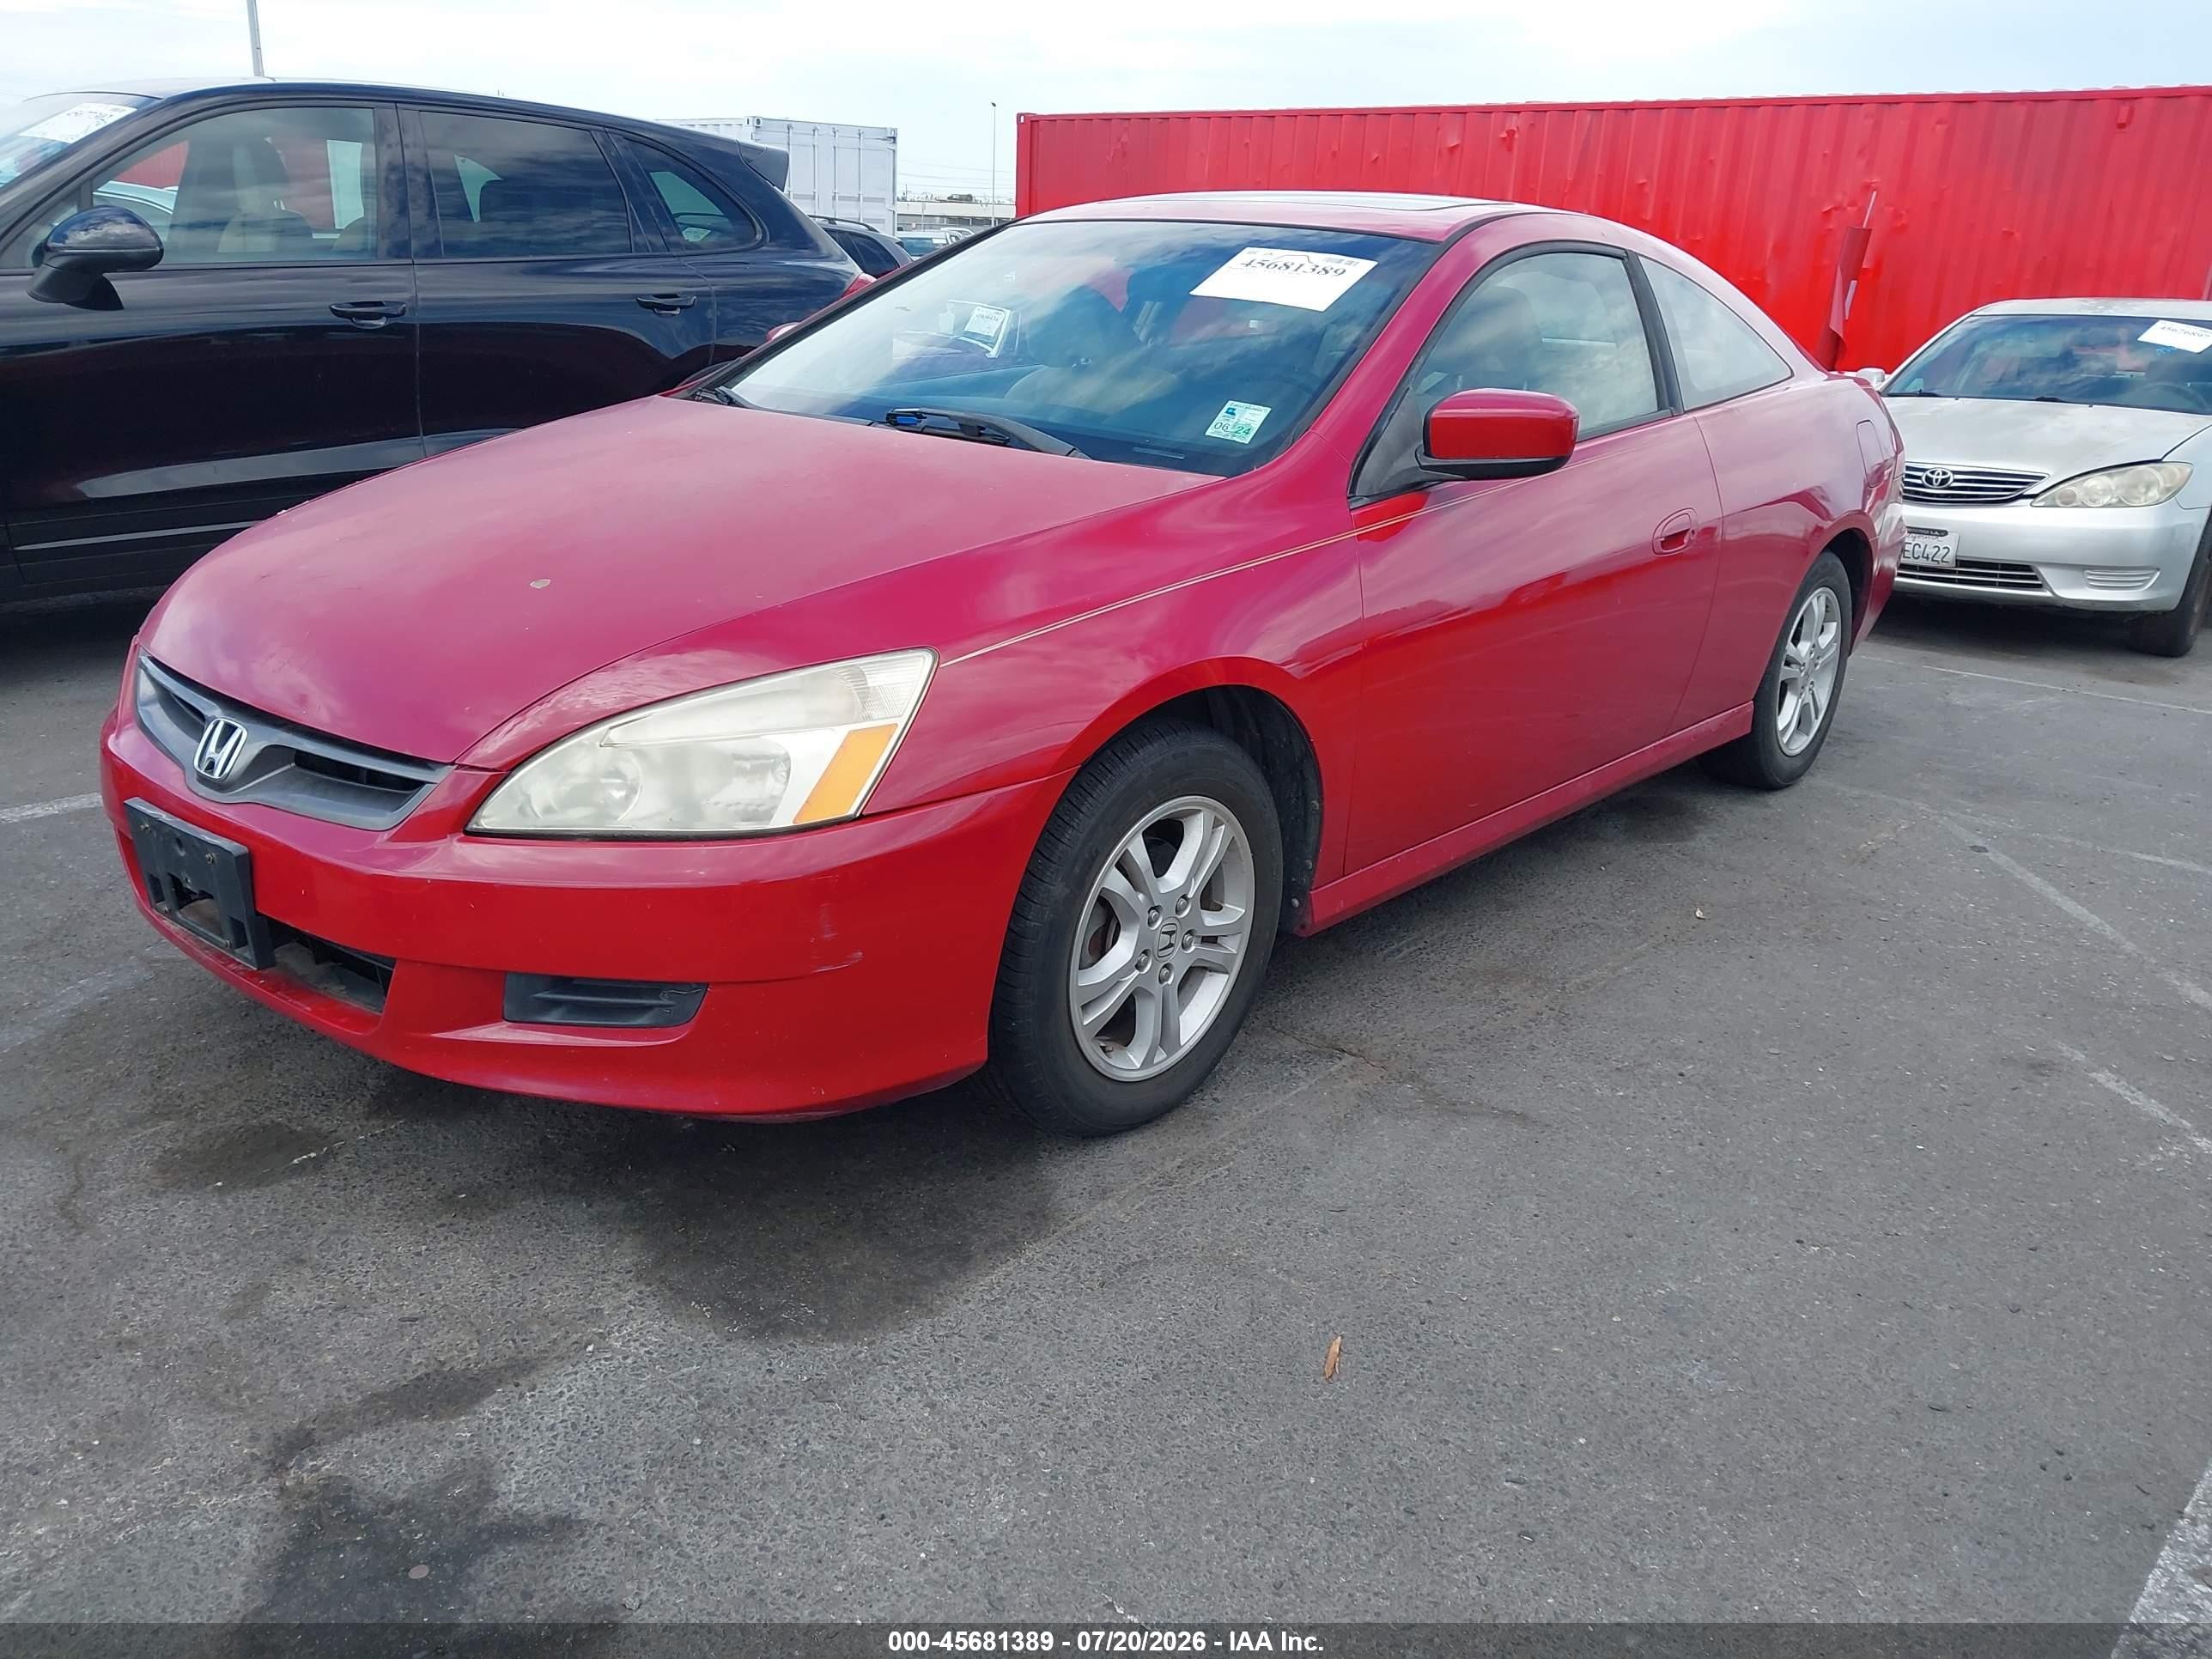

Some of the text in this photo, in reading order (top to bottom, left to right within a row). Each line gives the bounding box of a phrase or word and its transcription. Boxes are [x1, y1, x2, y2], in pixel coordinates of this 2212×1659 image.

[1240, 258, 1346, 276] 45681389
[1214, 422, 1252, 434] 06 24
[1901, 542, 1950, 563] EC422
